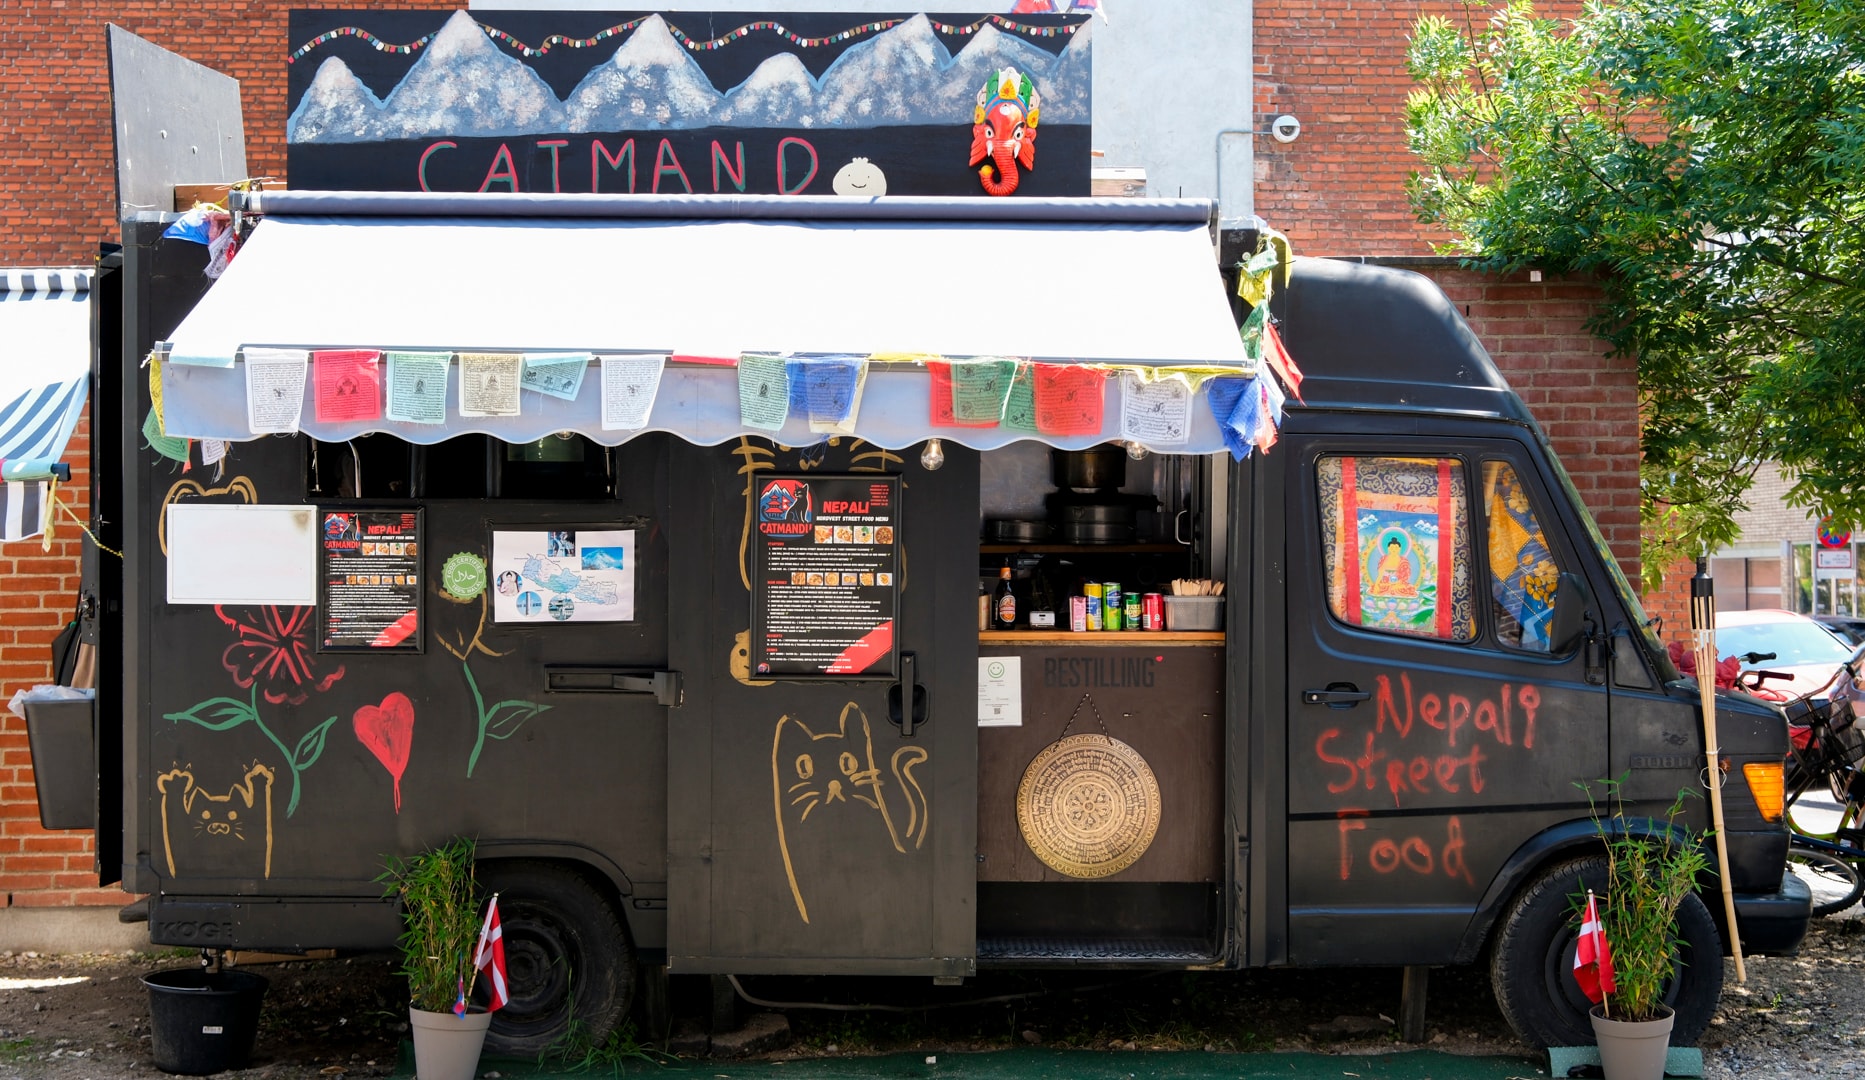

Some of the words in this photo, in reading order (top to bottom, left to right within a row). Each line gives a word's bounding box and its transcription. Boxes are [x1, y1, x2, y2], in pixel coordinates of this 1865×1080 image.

[822, 501, 870, 514] NEPALI
[368, 526, 400, 534] NEPALI
[446, 562, 456, 578] FOOD
[456, 557, 482, 573] CERTIFIED
[454, 570, 476, 583] حلال
[467, 581, 482, 593] HALAL
[1044, 657, 1154, 688] BESTILLING
[1376, 672, 1541, 749] Nepali
[1337, 806, 1475, 888] Food
